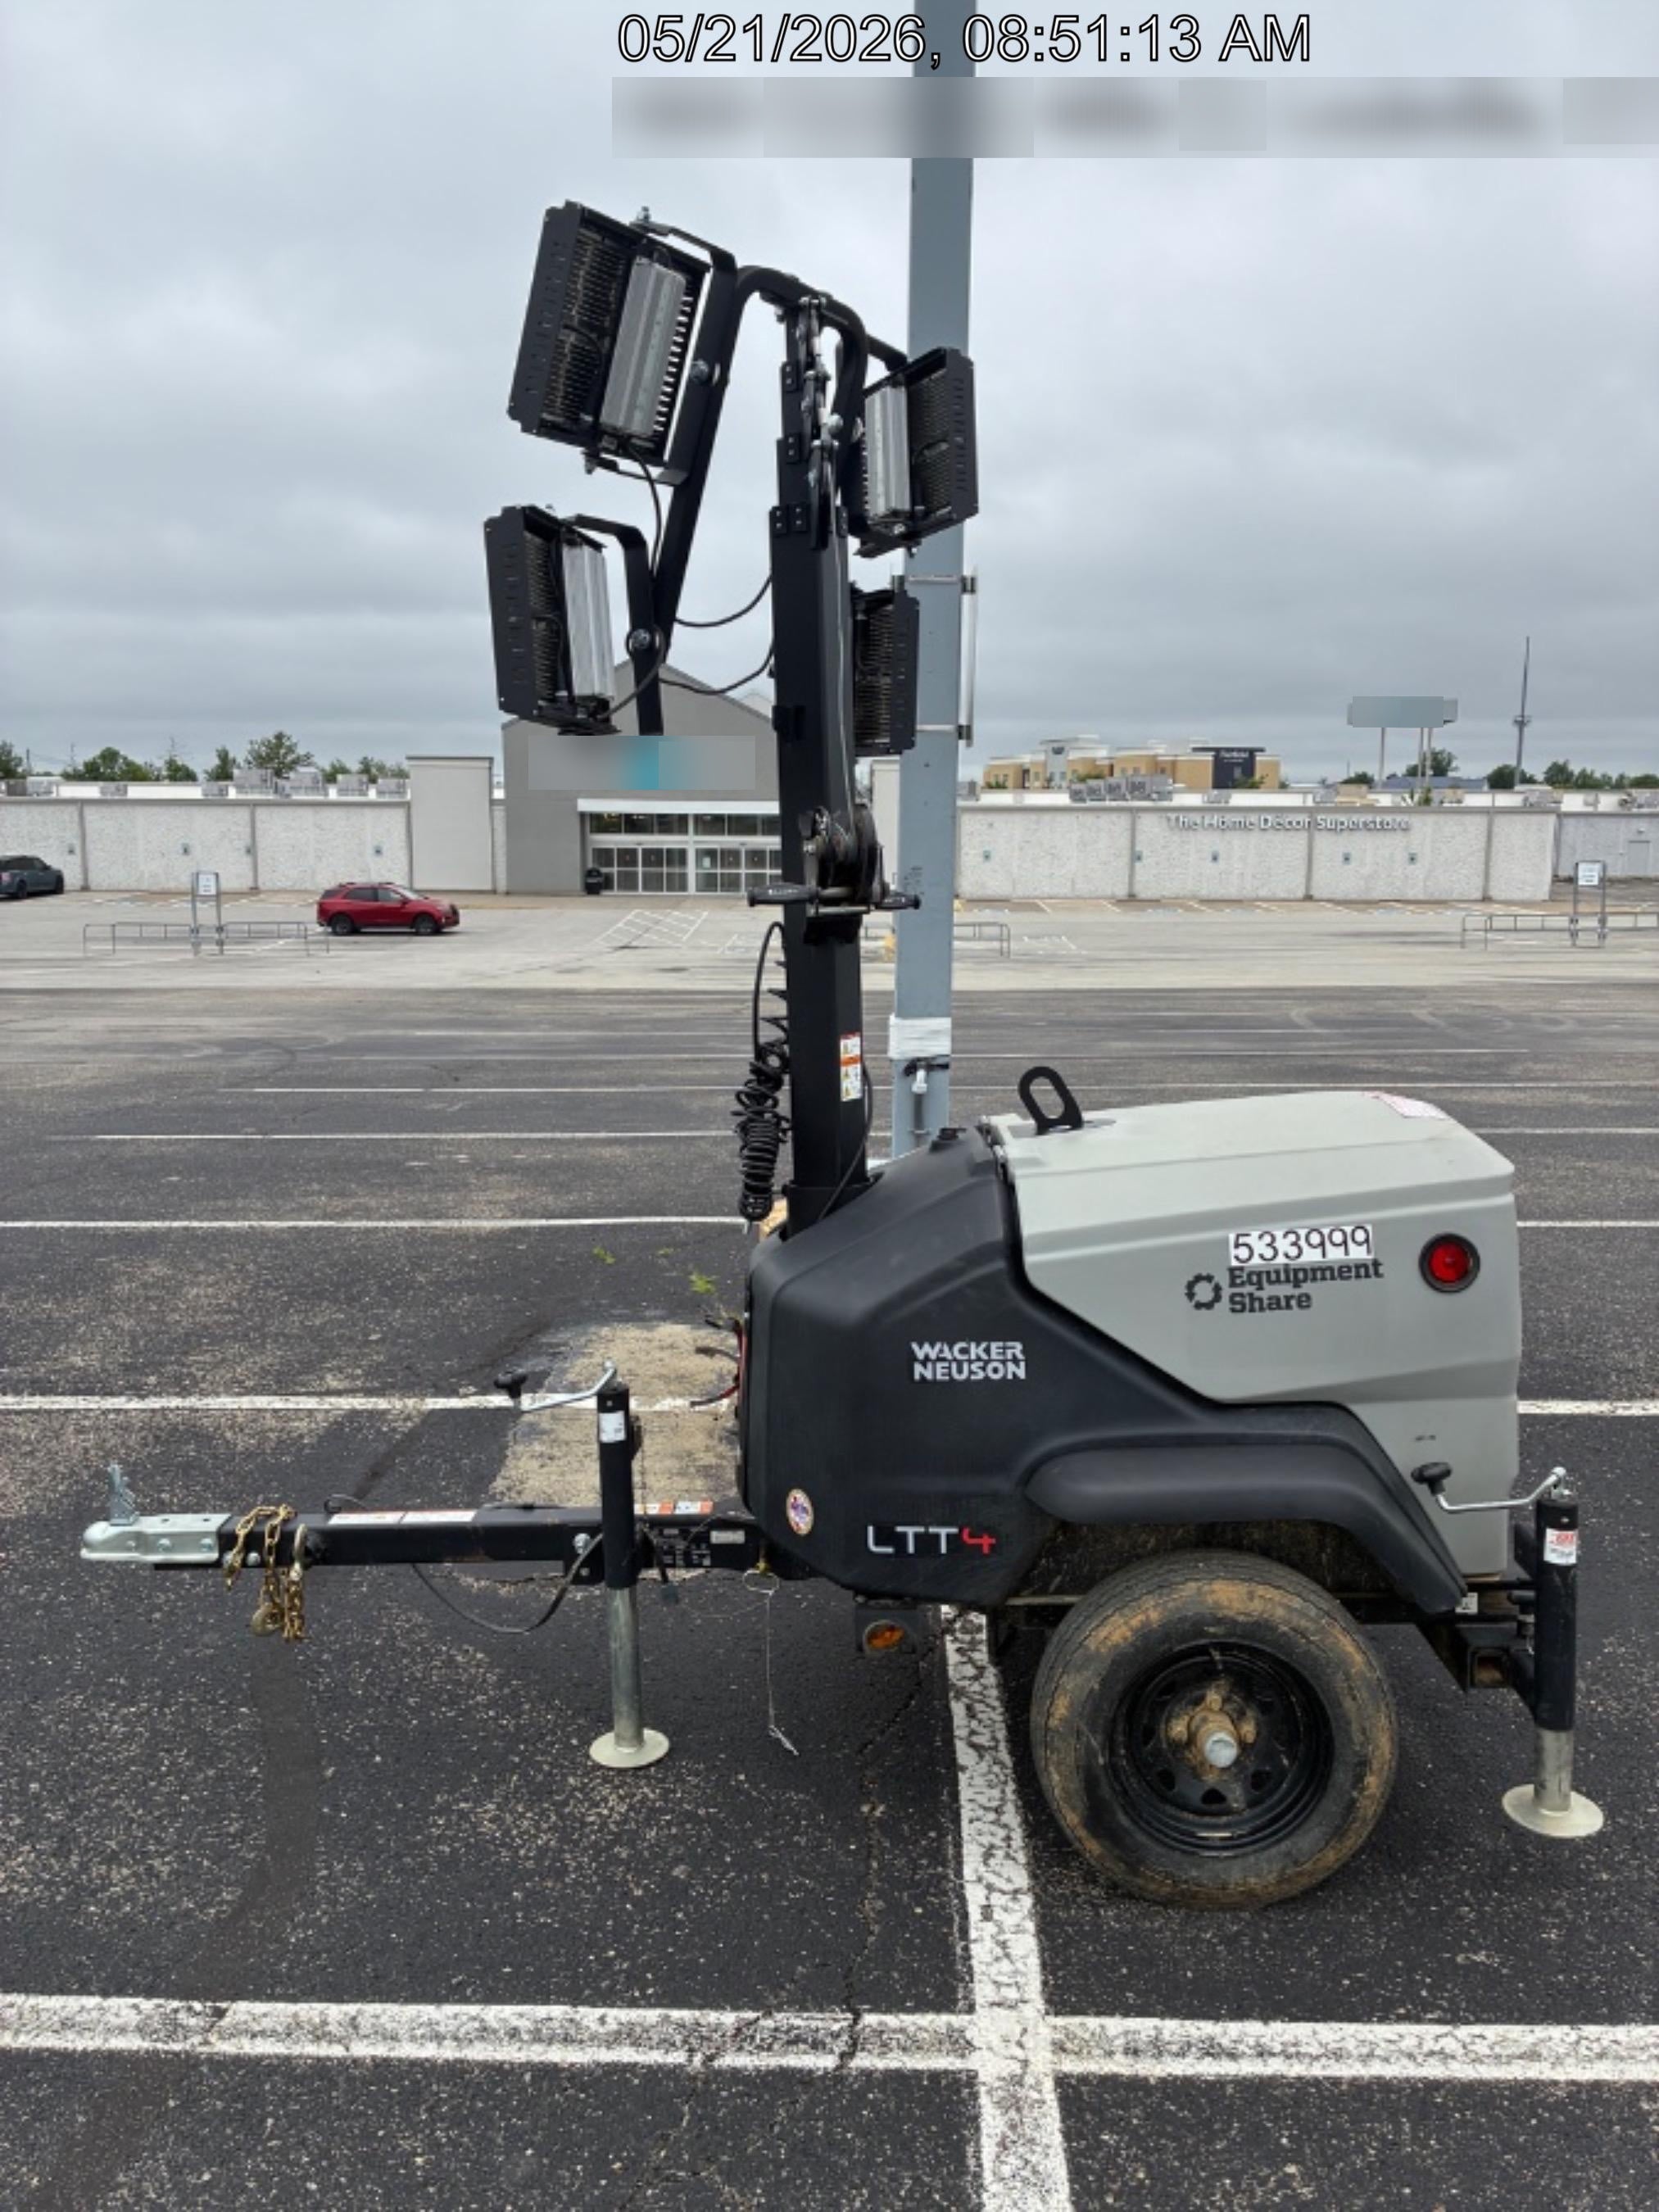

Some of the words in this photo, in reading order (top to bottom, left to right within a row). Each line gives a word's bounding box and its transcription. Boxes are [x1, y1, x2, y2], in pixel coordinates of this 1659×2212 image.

[1167, 815, 1199, 830] The
[1202, 815, 1255, 830] Home
[1316, 814, 1410, 832] Superstore
[1231, 1224, 1372, 1264] 533999
[1227, 1258, 1384, 1290] Equipment
[1228, 1291, 1312, 1314] Share
[911, 1341, 1023, 1361] WACKER
[913, 1361, 1026, 1381] NEUSON
[867, 1525, 996, 1554] LTT4
